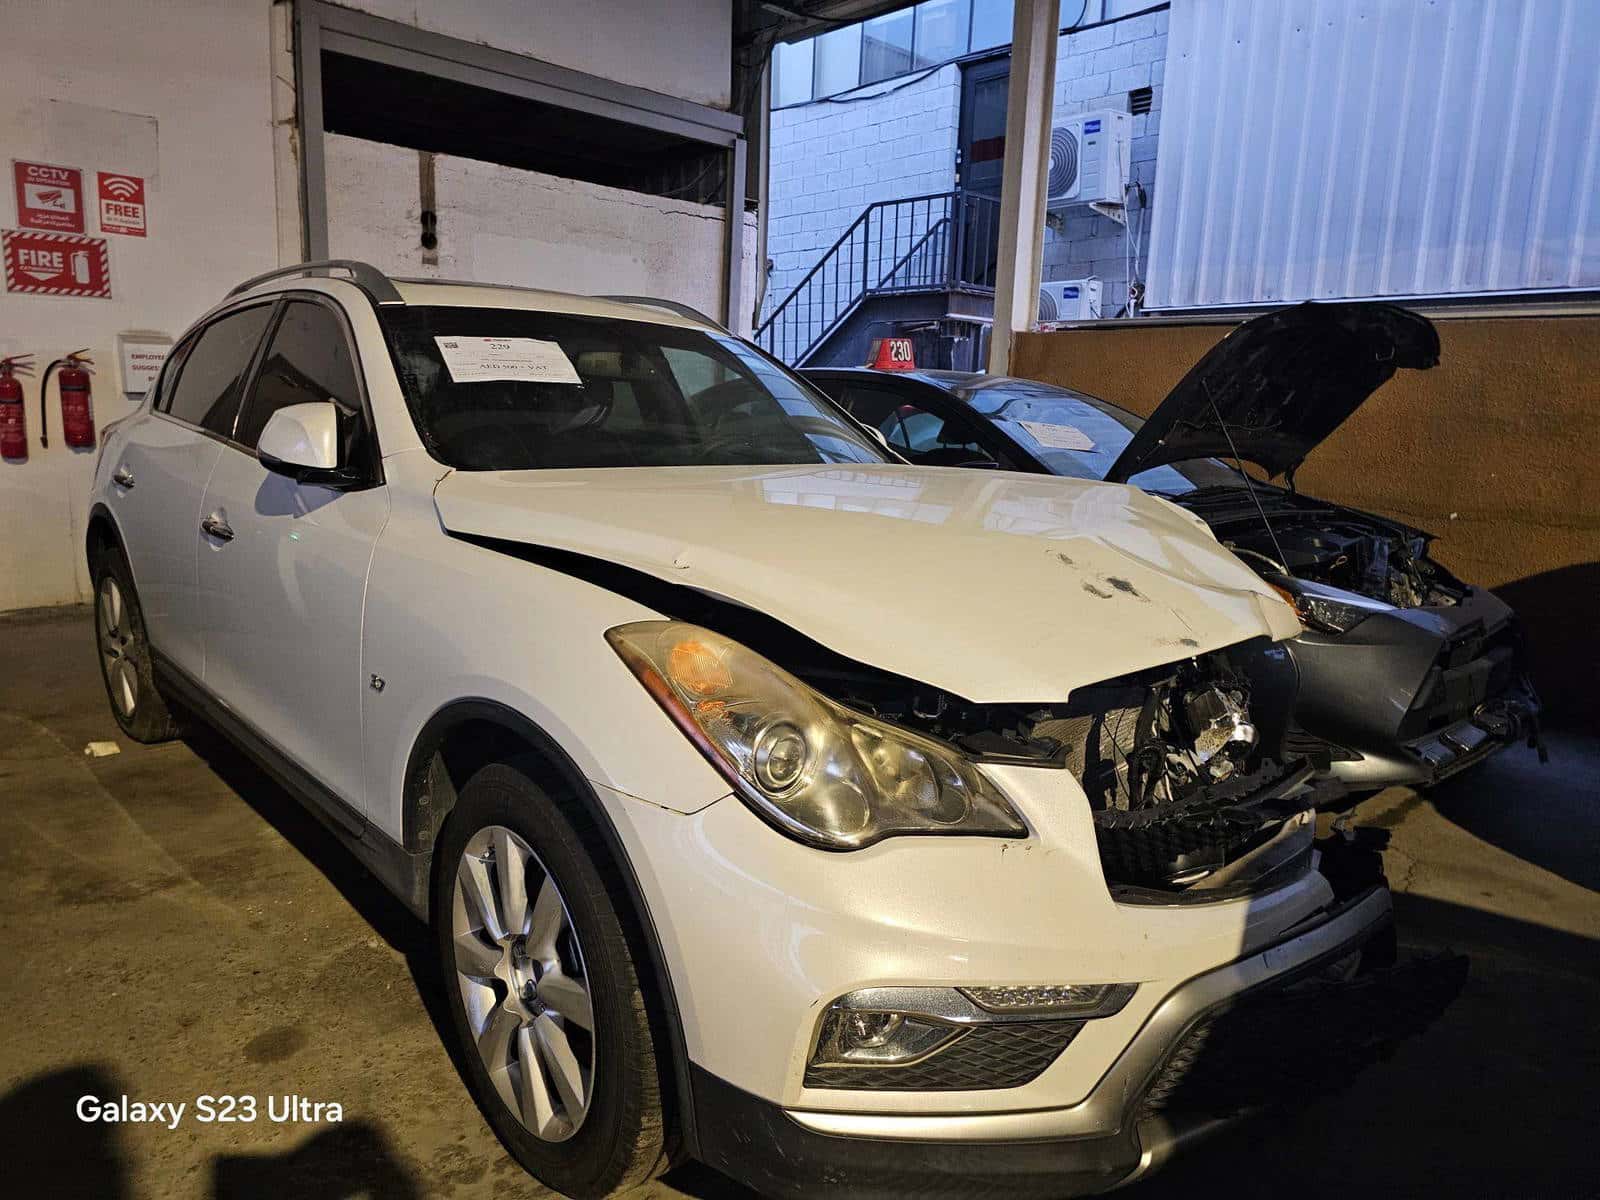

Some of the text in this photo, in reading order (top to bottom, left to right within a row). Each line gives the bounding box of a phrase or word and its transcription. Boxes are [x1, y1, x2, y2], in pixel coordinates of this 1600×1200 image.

[28, 166, 69, 180] CCTV
[106, 203, 140, 218] FREE
[18, 249, 64, 267] FIRE
[890, 341, 911, 361] 230
